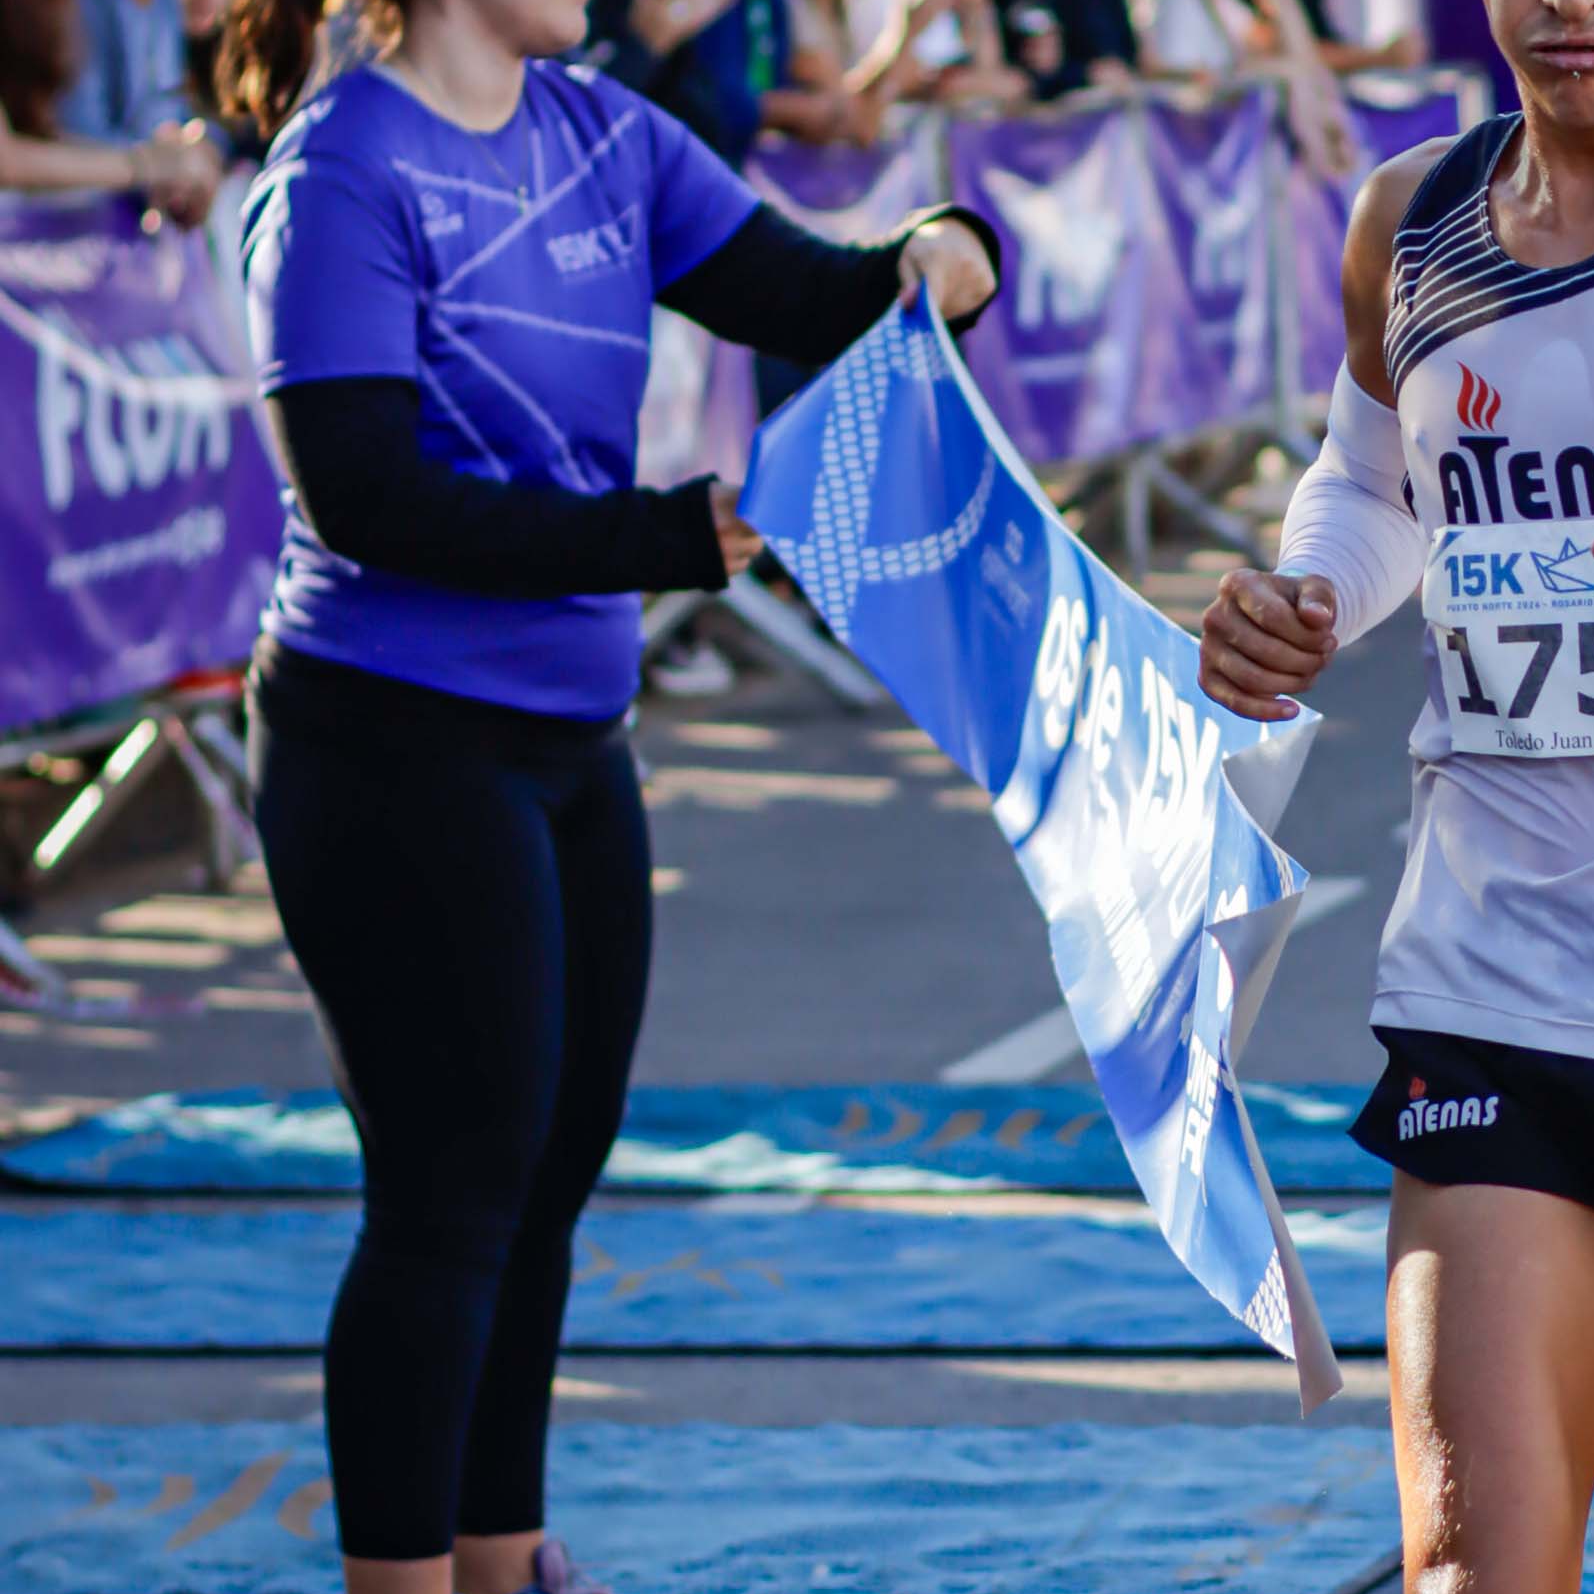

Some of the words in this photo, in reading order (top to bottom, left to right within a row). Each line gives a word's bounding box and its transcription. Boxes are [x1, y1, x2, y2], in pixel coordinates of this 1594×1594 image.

[1444, 553, 1524, 597] 15K
[1482, 601, 1512, 612] NORTE
[1551, 598, 1593, 609] ROSARIO
[1495, 729, 1544, 751] Toledo
[1550, 731, 1593, 750] Juan
[1398, 1095, 1499, 1141] ATENAS
